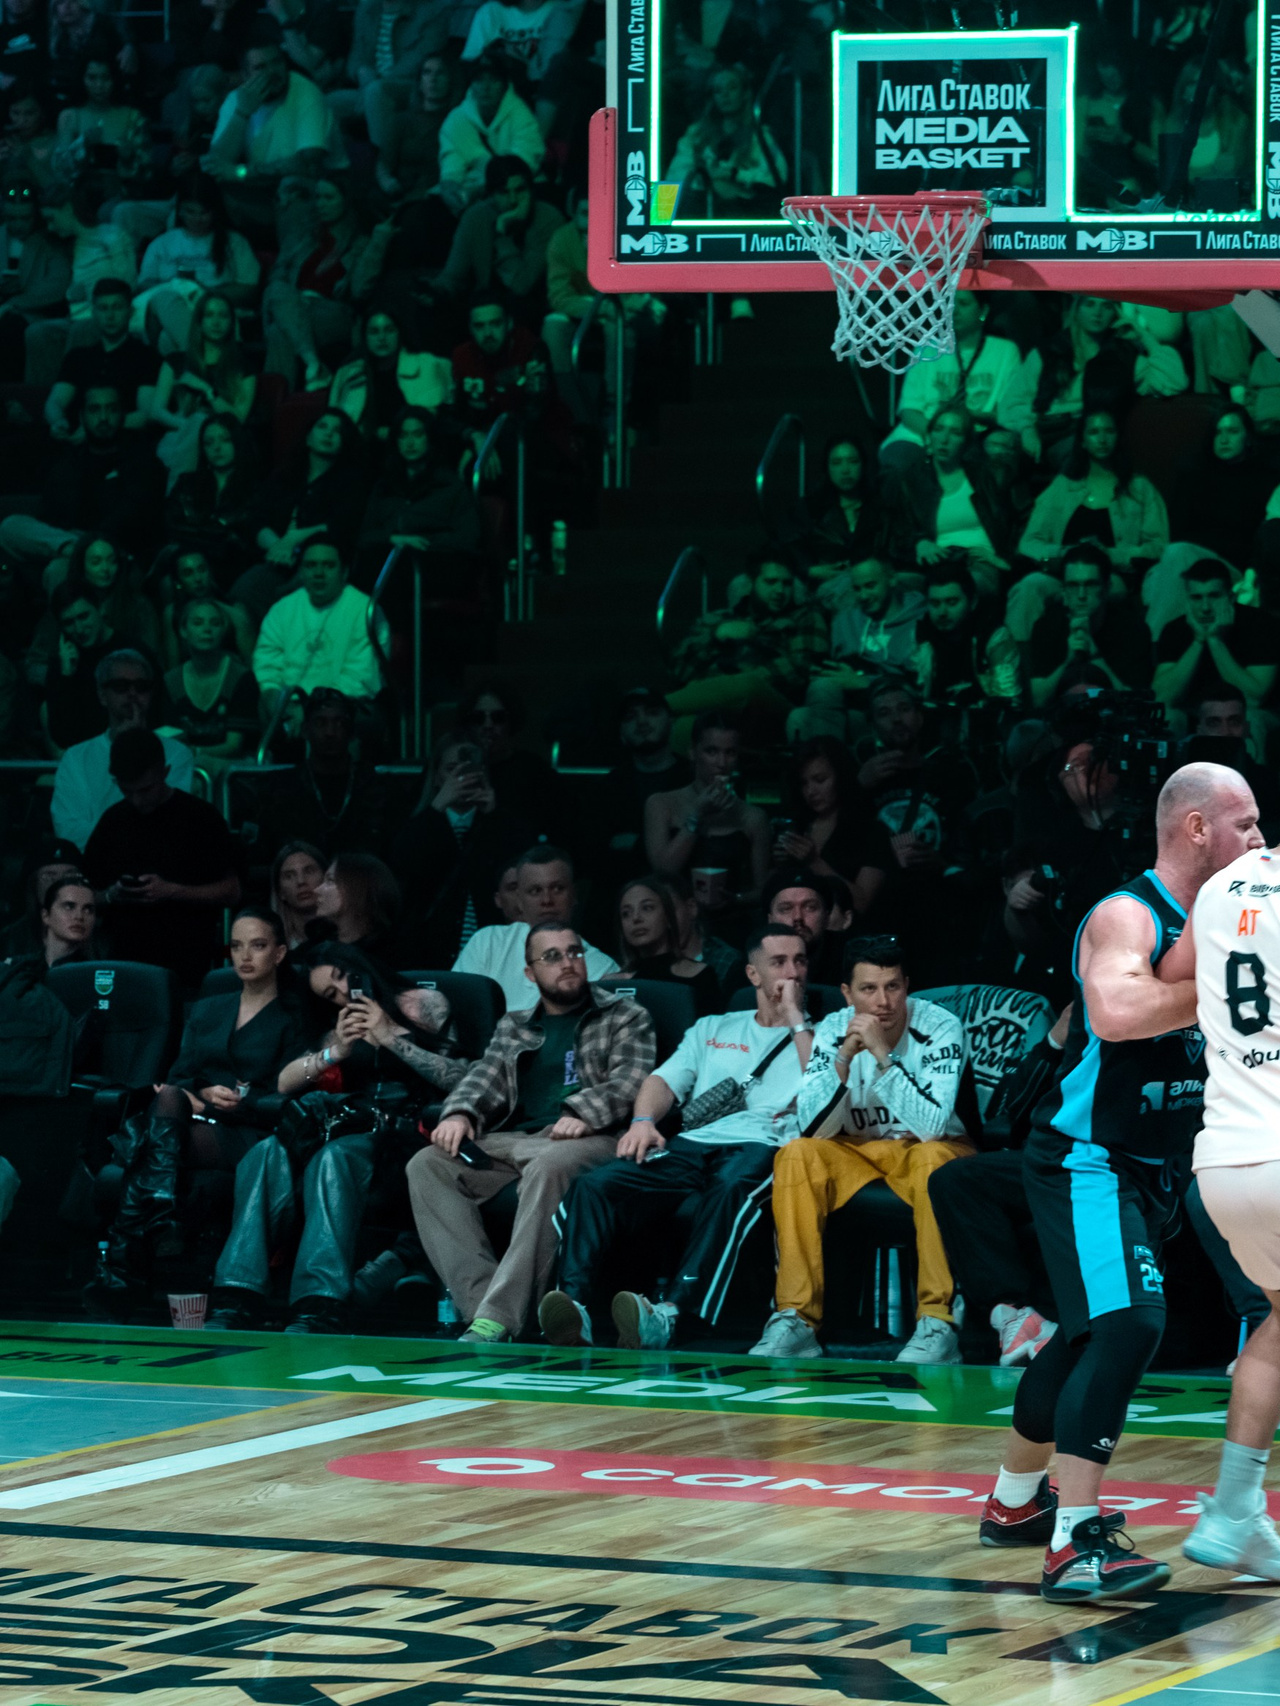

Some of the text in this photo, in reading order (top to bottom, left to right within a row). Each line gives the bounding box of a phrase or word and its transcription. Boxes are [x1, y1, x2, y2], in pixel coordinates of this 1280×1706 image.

[875, 116, 1030, 144] MEDIA
[875, 147, 1030, 169] BASKET
[1225, 950, 1274, 1037] 8
[288, 1365, 938, 1411] MEDIA
[581, 1468, 1206, 1517] самоат
